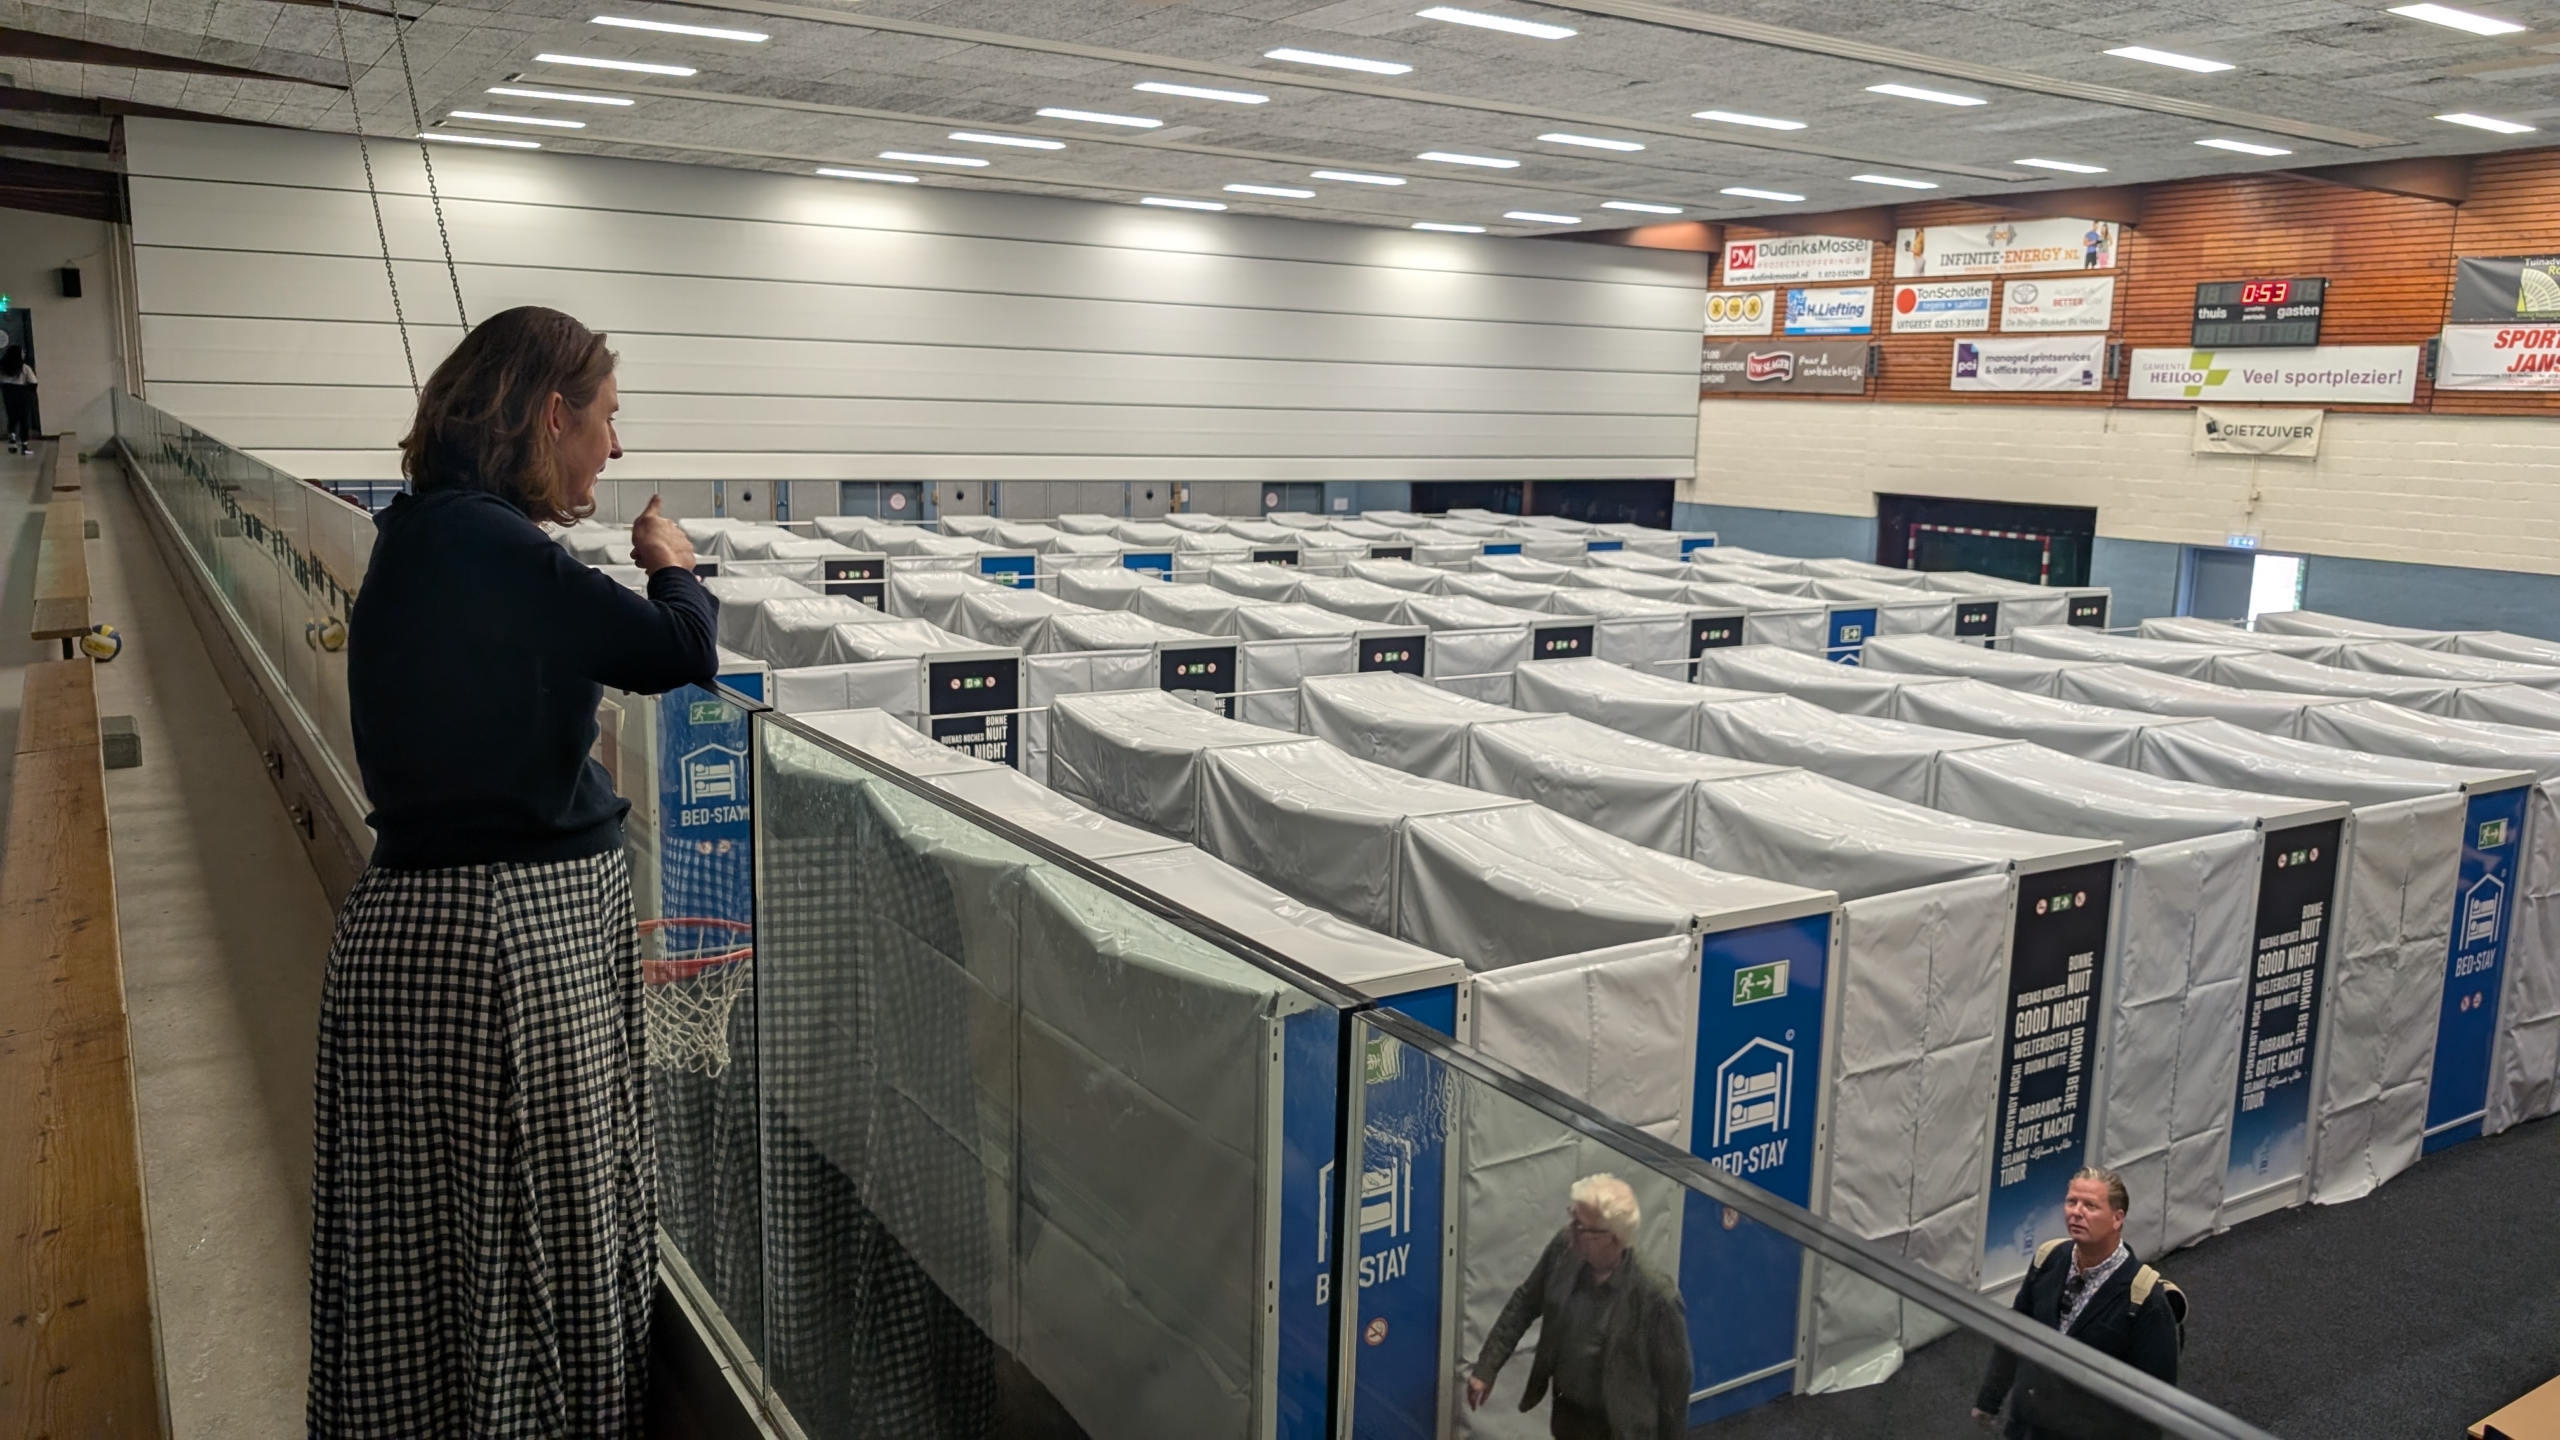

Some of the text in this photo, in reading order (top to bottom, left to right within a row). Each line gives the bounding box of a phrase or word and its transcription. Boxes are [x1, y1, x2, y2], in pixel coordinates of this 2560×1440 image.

[1758, 238, 1869, 257] Dudink&Mossel
[1917, 286, 1989, 299] TonScholten
[2242, 284, 2287, 303] 0:53
[1807, 303, 1865, 318] H.Liefting
[2008, 306, 2039, 314] TOYOTA
[2053, 298, 2084, 307] BETTER
[2198, 307, 2228, 319] thuis
[2277, 305, 2319, 319] gasten
[1897, 320, 1932, 329] UITGEEST
[1986, 352, 2091, 364] managed printservices
[1985, 365, 2058, 376] & office supplies
[2150, 372, 2203, 384] HEILOO
[2243, 369, 2403, 388] Veel sportplezier!
[2223, 424, 2314, 438] GIETZUIVER
[986, 715, 1008, 726] BONNE
[986, 726, 1008, 741] NUIT
[975, 742, 1007, 760] NIGHT
[681, 805, 745, 827] BED-STAY
[2300, 917, 2322, 941] NUIT
[2257, 941, 2320, 978] GOOD NIGHT
[2454, 948, 2497, 978] BED-STAY
[2067, 969, 2092, 996] NUIT
[2295, 968, 2315, 1046] DORMI BENE
[2015, 995, 2089, 1039] GOOD NIGHT
[2014, 1030, 2070, 1060] WELTERUSTEN
[2063, 1026, 2085, 1112] DORMI BENE
[2015, 1113, 2076, 1149] GUTE NACHT
